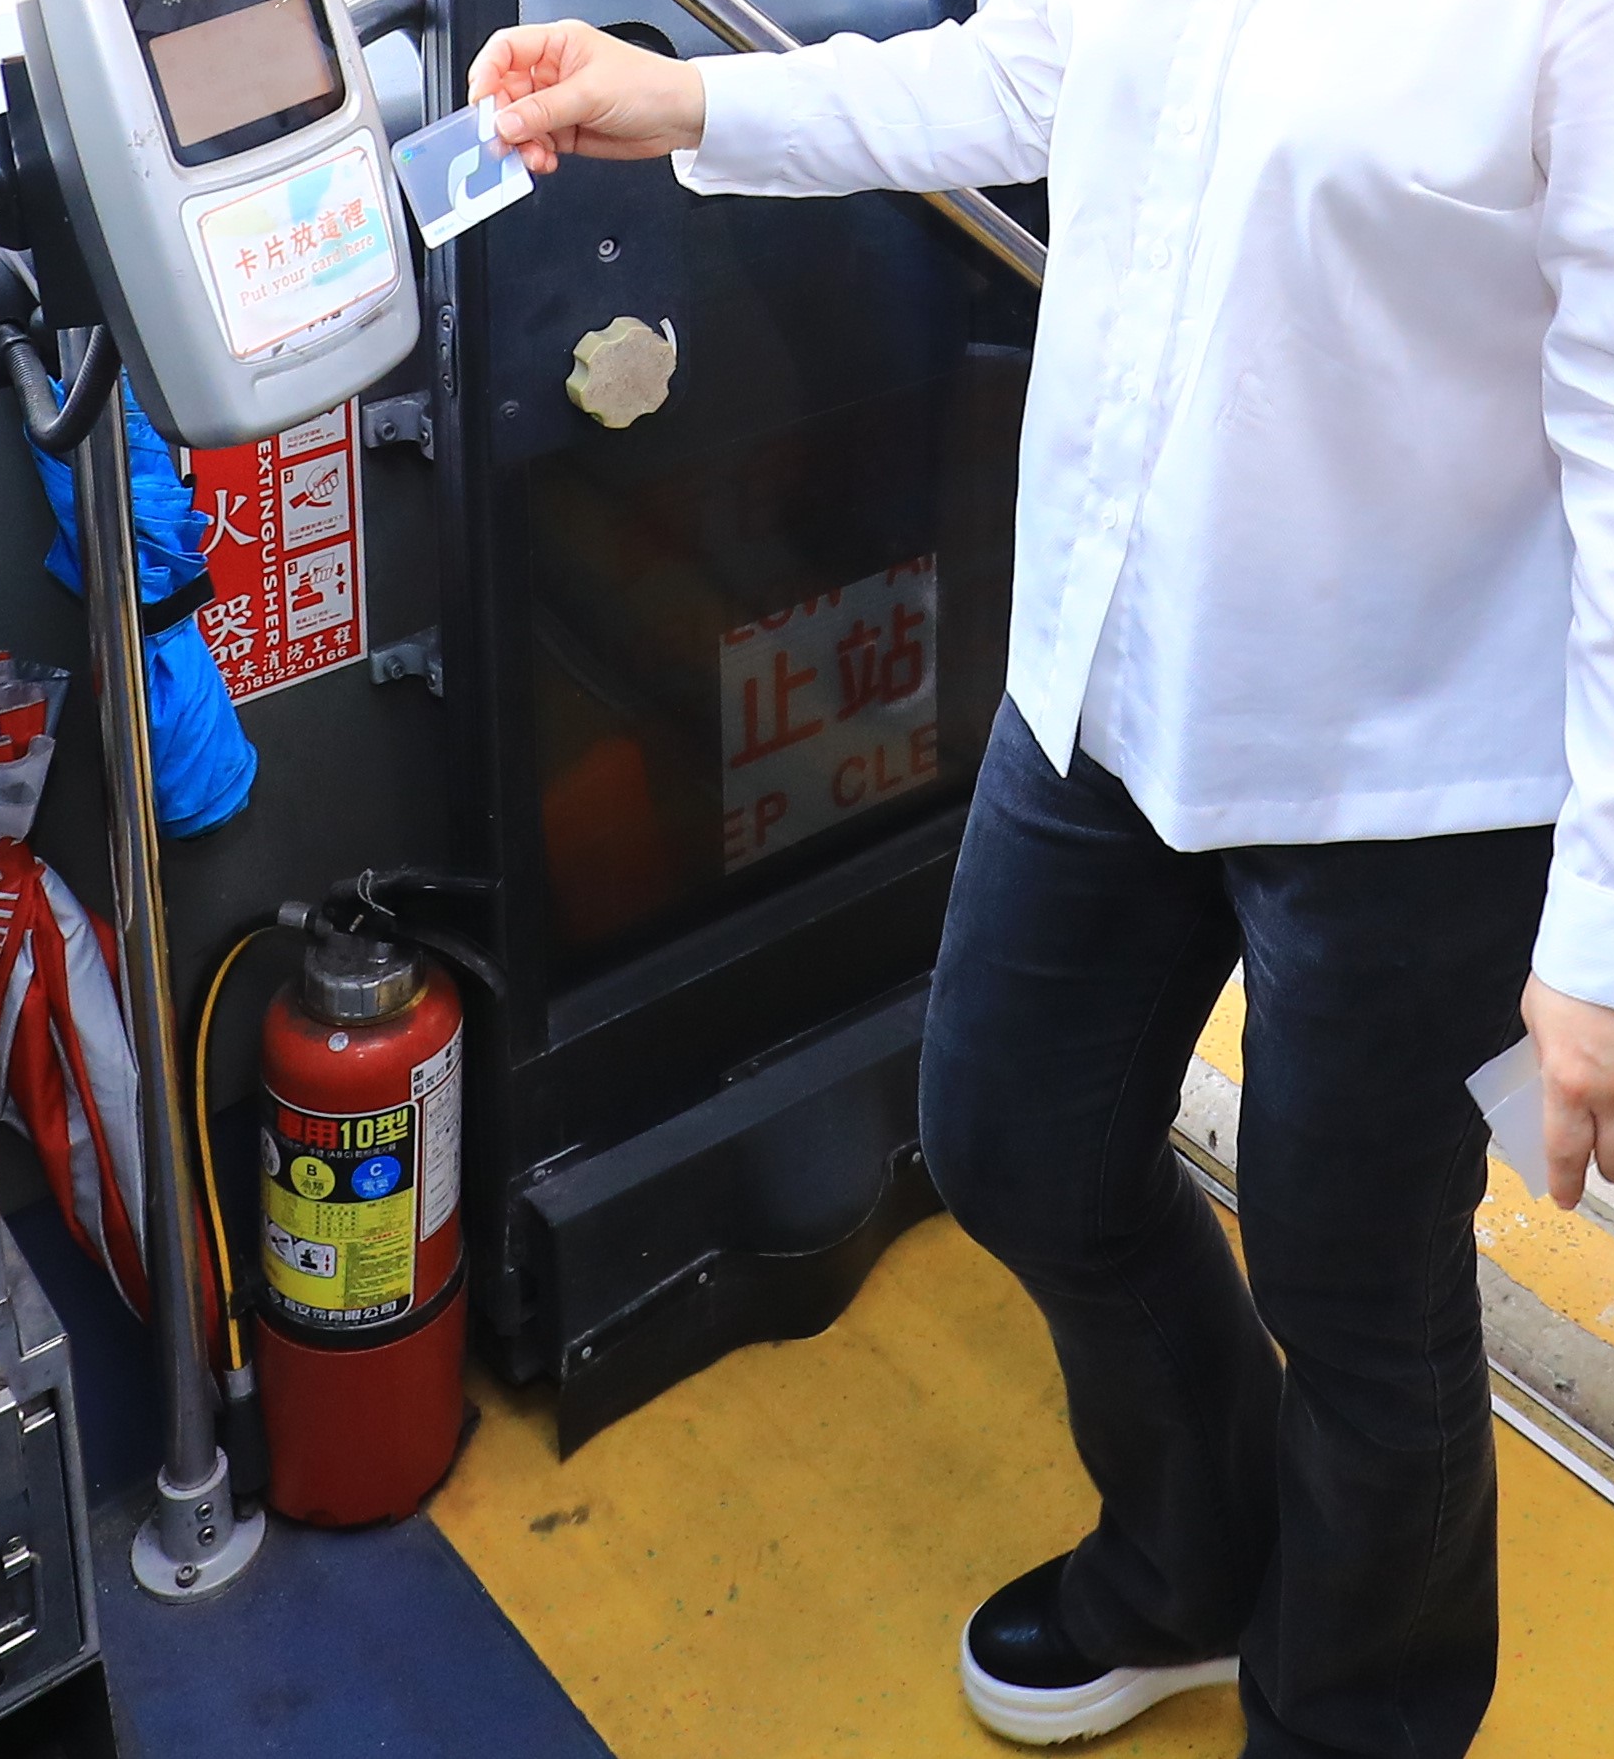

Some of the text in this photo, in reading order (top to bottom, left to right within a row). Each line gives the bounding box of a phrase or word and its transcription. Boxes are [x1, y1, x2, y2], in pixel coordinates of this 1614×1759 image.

[235, 196, 368, 280] 卡片放這裡
[239, 235, 374, 307] Put your card here
[257, 439, 282, 648] EXTINGUISHER
[306, 1163, 318, 1177] B
[369, 1162, 384, 1177] C
